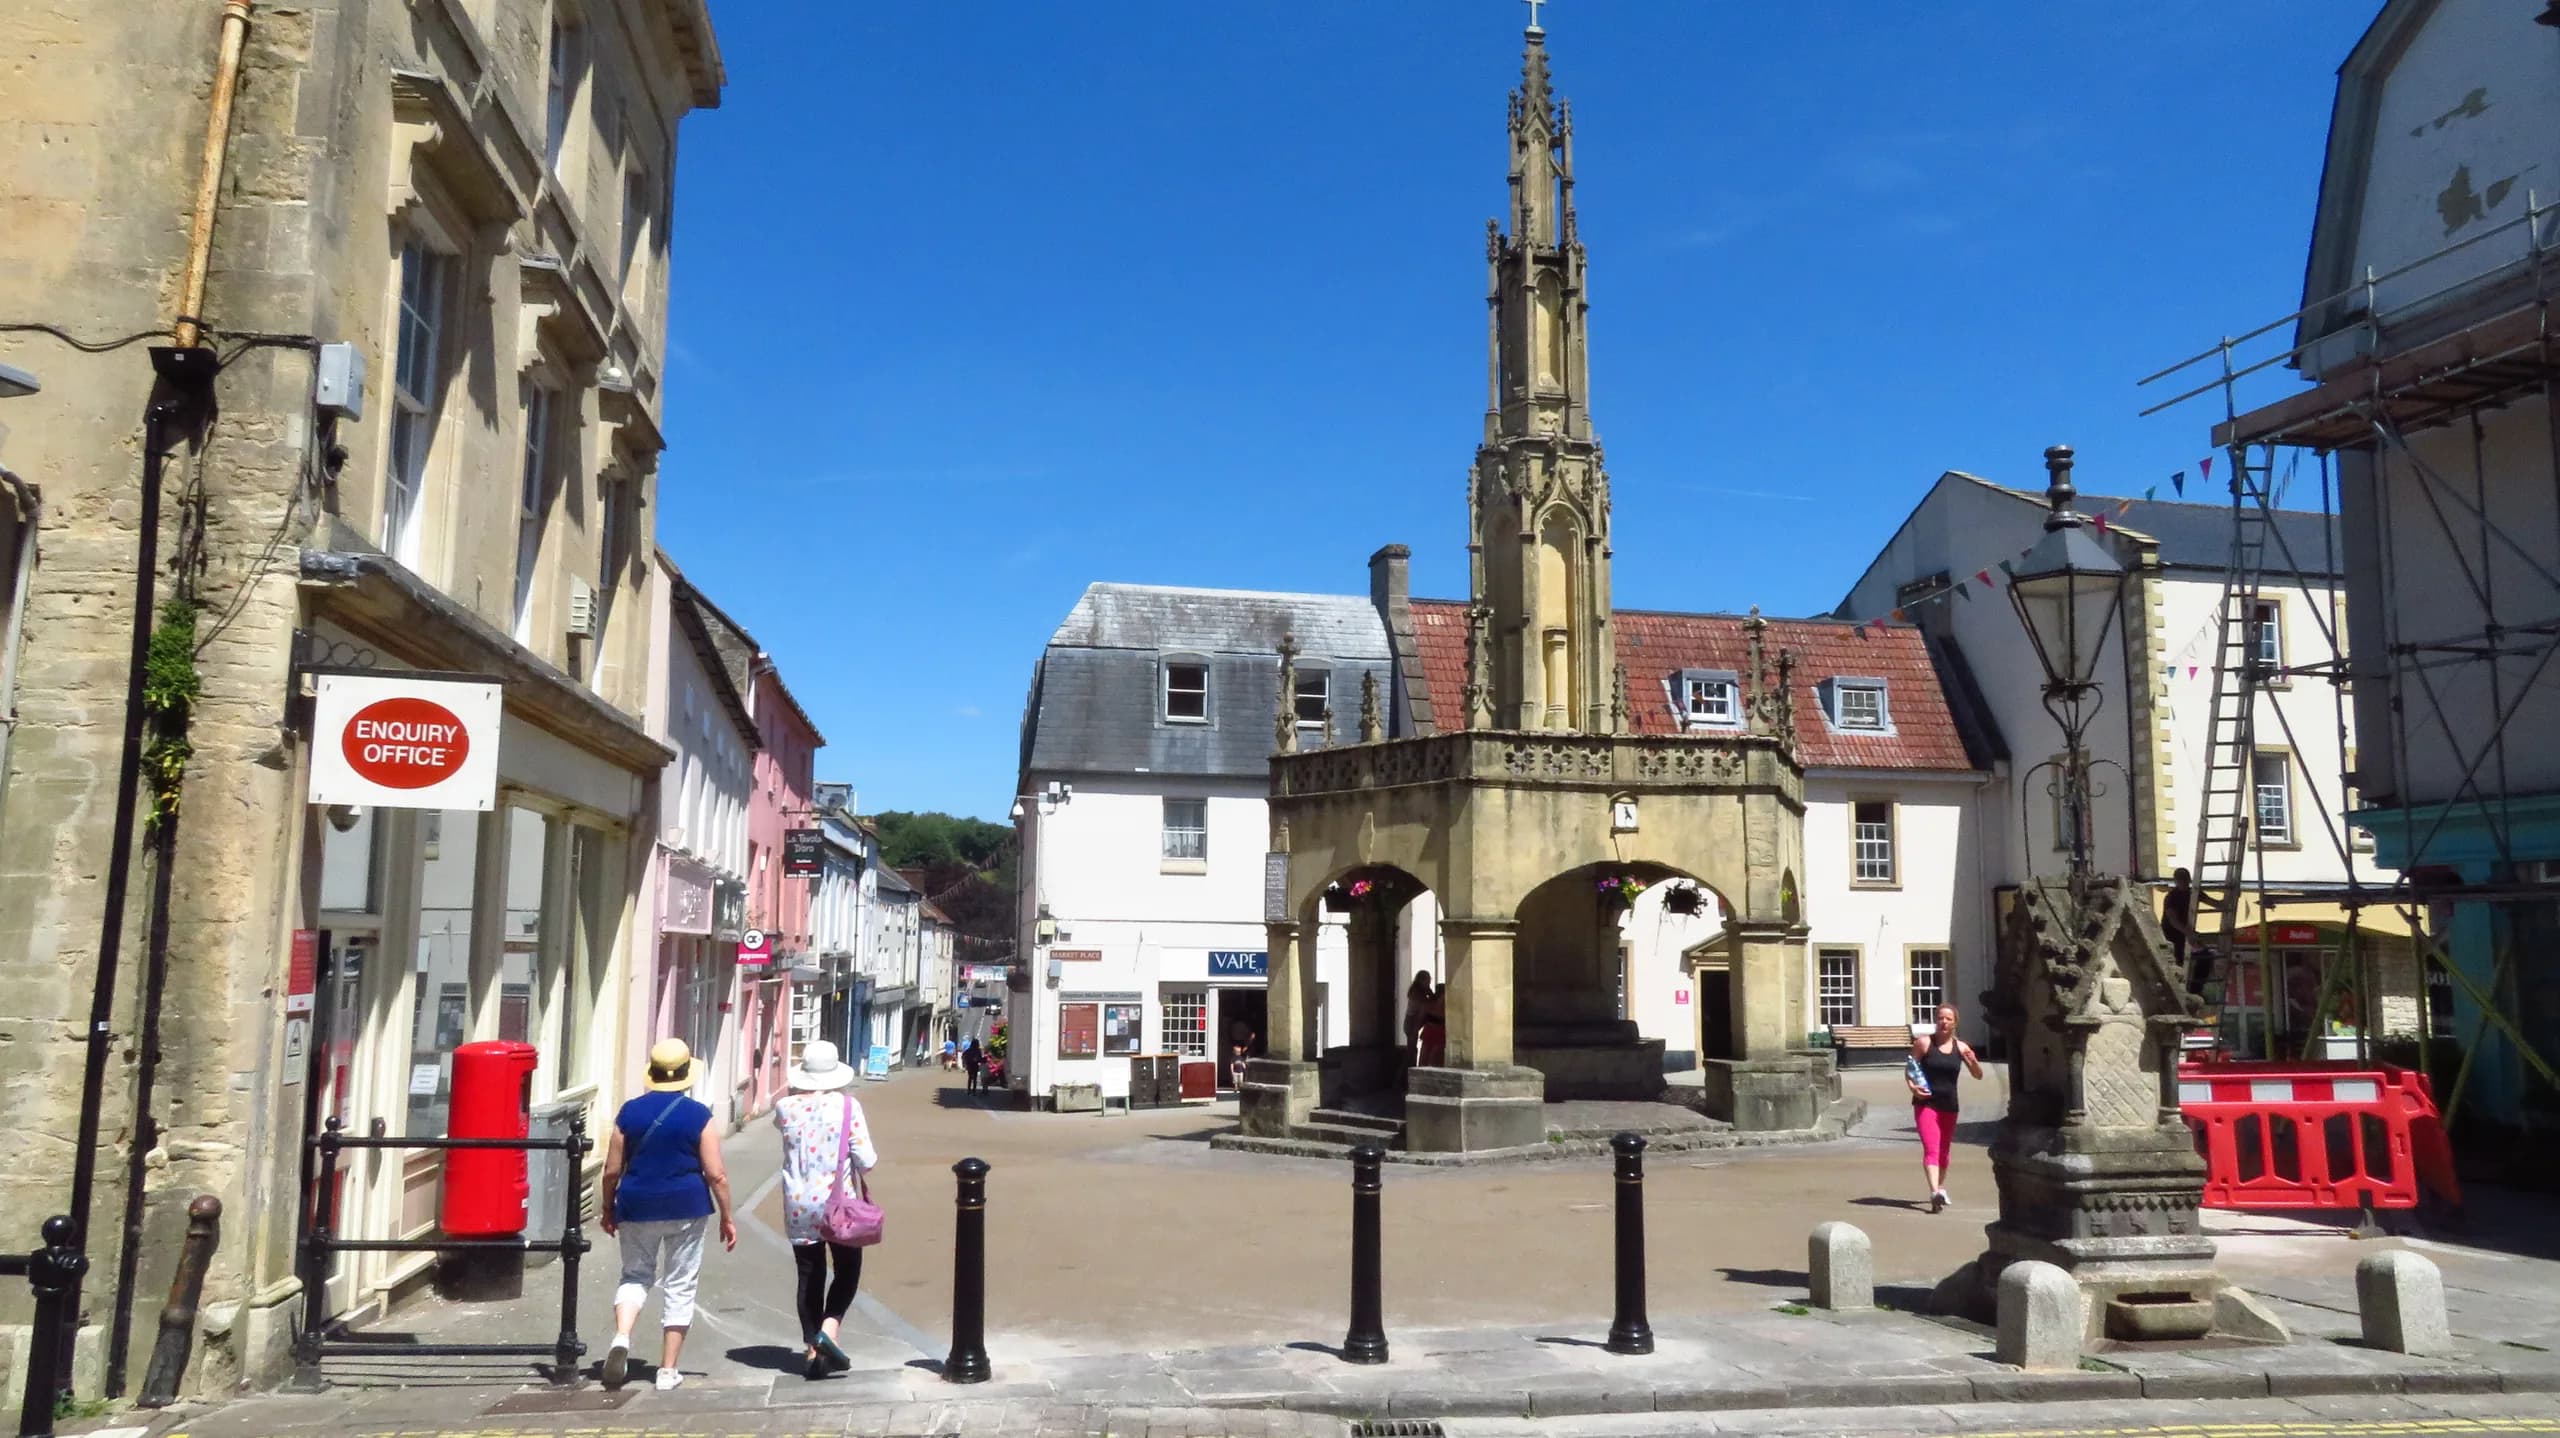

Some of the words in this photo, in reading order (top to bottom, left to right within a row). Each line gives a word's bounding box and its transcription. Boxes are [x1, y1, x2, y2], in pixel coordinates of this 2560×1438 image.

[356, 719, 458, 744] ENQUIRY
[363, 743, 447, 767] OFFICE
[1051, 952, 1078, 960] MARKET
[1080, 952, 1100, 960] PLACE
[1214, 953, 1257, 969] VAPE
